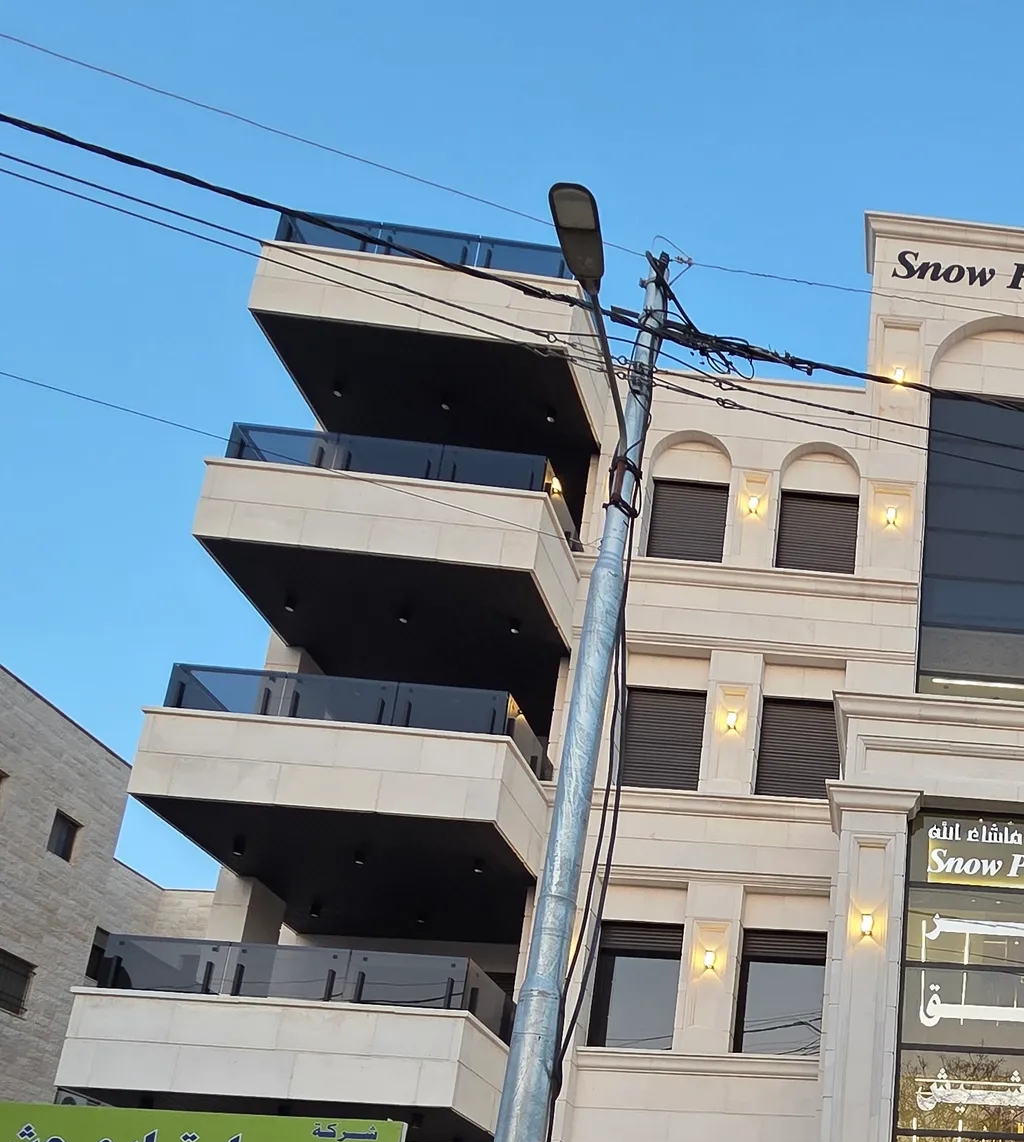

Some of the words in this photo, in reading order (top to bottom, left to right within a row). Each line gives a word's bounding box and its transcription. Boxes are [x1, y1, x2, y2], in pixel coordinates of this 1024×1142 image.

[892, 250, 996, 287] Snow
[928, 820, 962, 841] الله
[927, 848, 1003, 877] Snow
[311, 1122, 378, 1142] شركة
